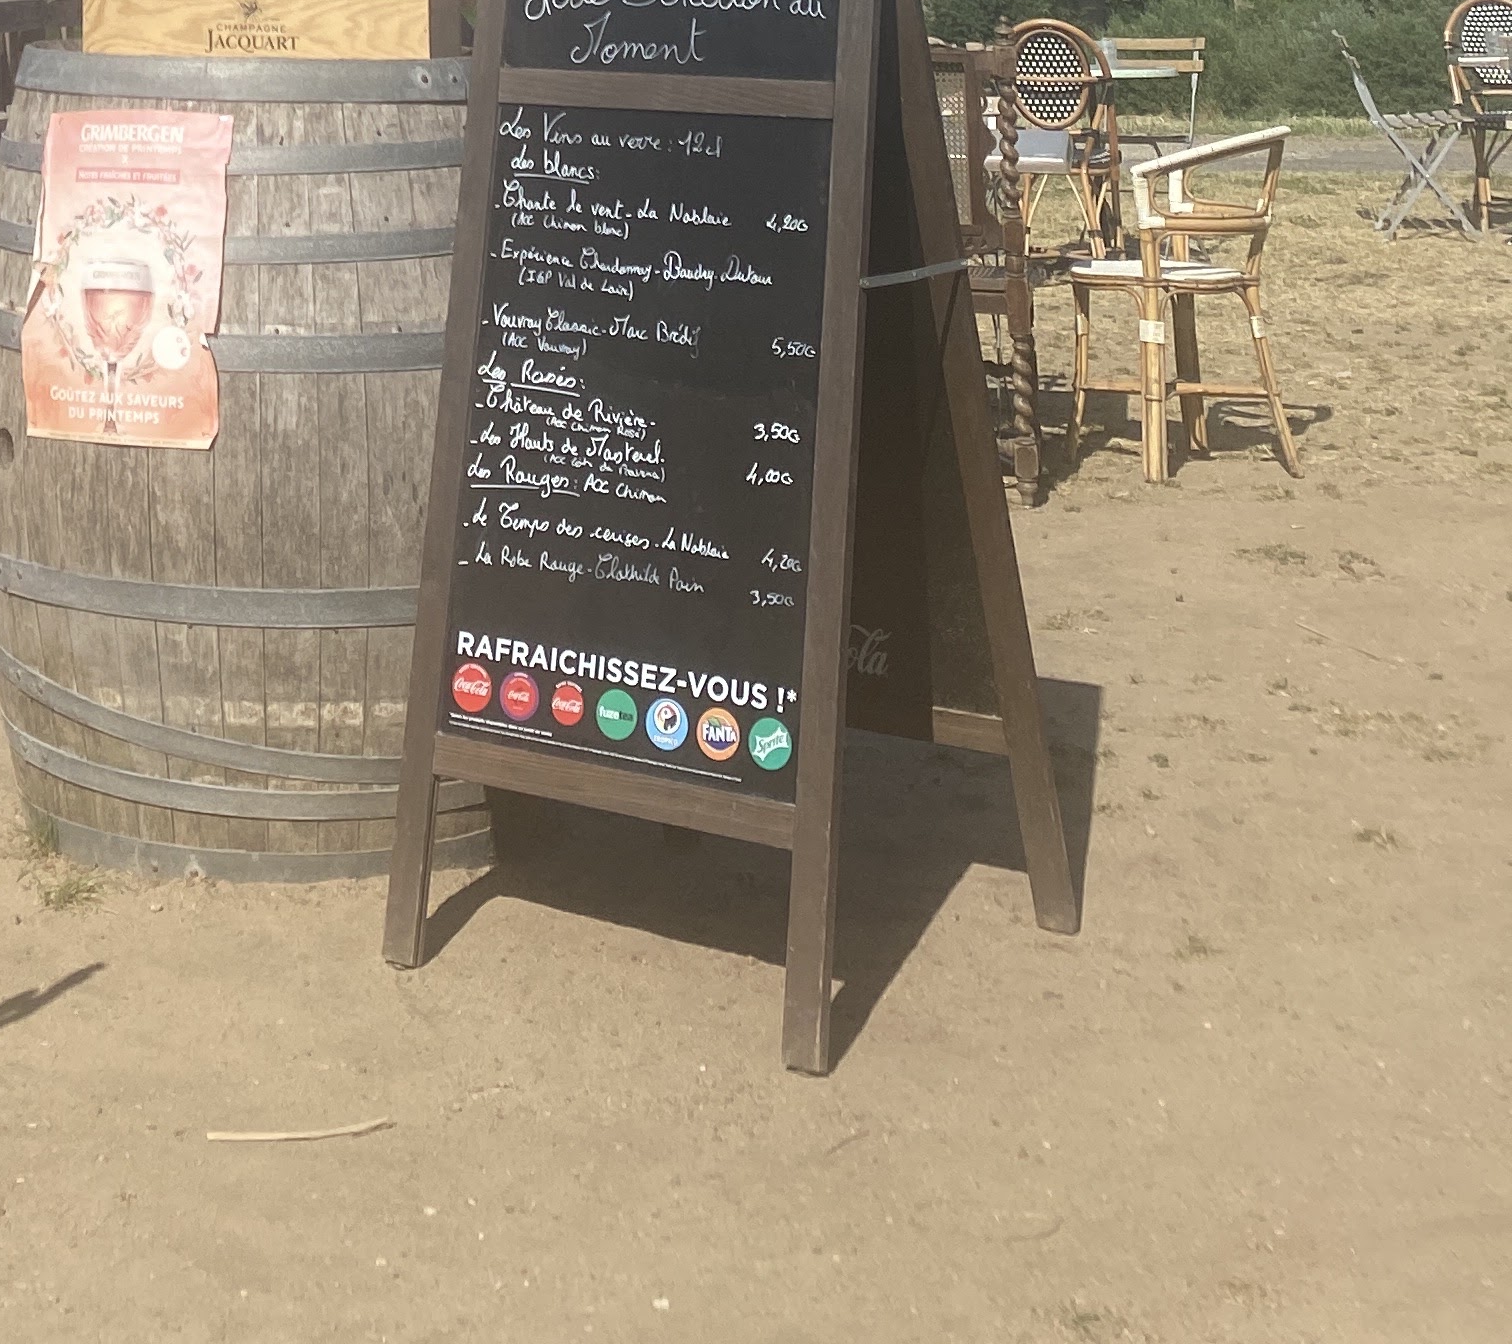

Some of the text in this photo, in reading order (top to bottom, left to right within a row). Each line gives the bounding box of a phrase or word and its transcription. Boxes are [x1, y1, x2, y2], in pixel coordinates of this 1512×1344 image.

[216, 23, 287, 34] CHAMPAGNE
[570, 12, 707, 64] Moment
[205, 27, 300, 54] JACQUART
[80, 123, 185, 144] GRIMBERGEN
[499, 107, 532, 140] Les
[543, 112, 583, 145] Vins
[591, 133, 612, 148] au
[477, 350, 508, 383] Les
[99, 391, 123, 406] AUX
[126, 393, 185, 410] SAVEURS
[68, 406, 160, 425] DU PRINTEMPS
[561, 402, 584, 423] de
[560, 437, 579, 457] de
[456, 630, 769, 710] RAFRAICHISSEZ-VOUS
[757, 734, 785, 755] Sprite
